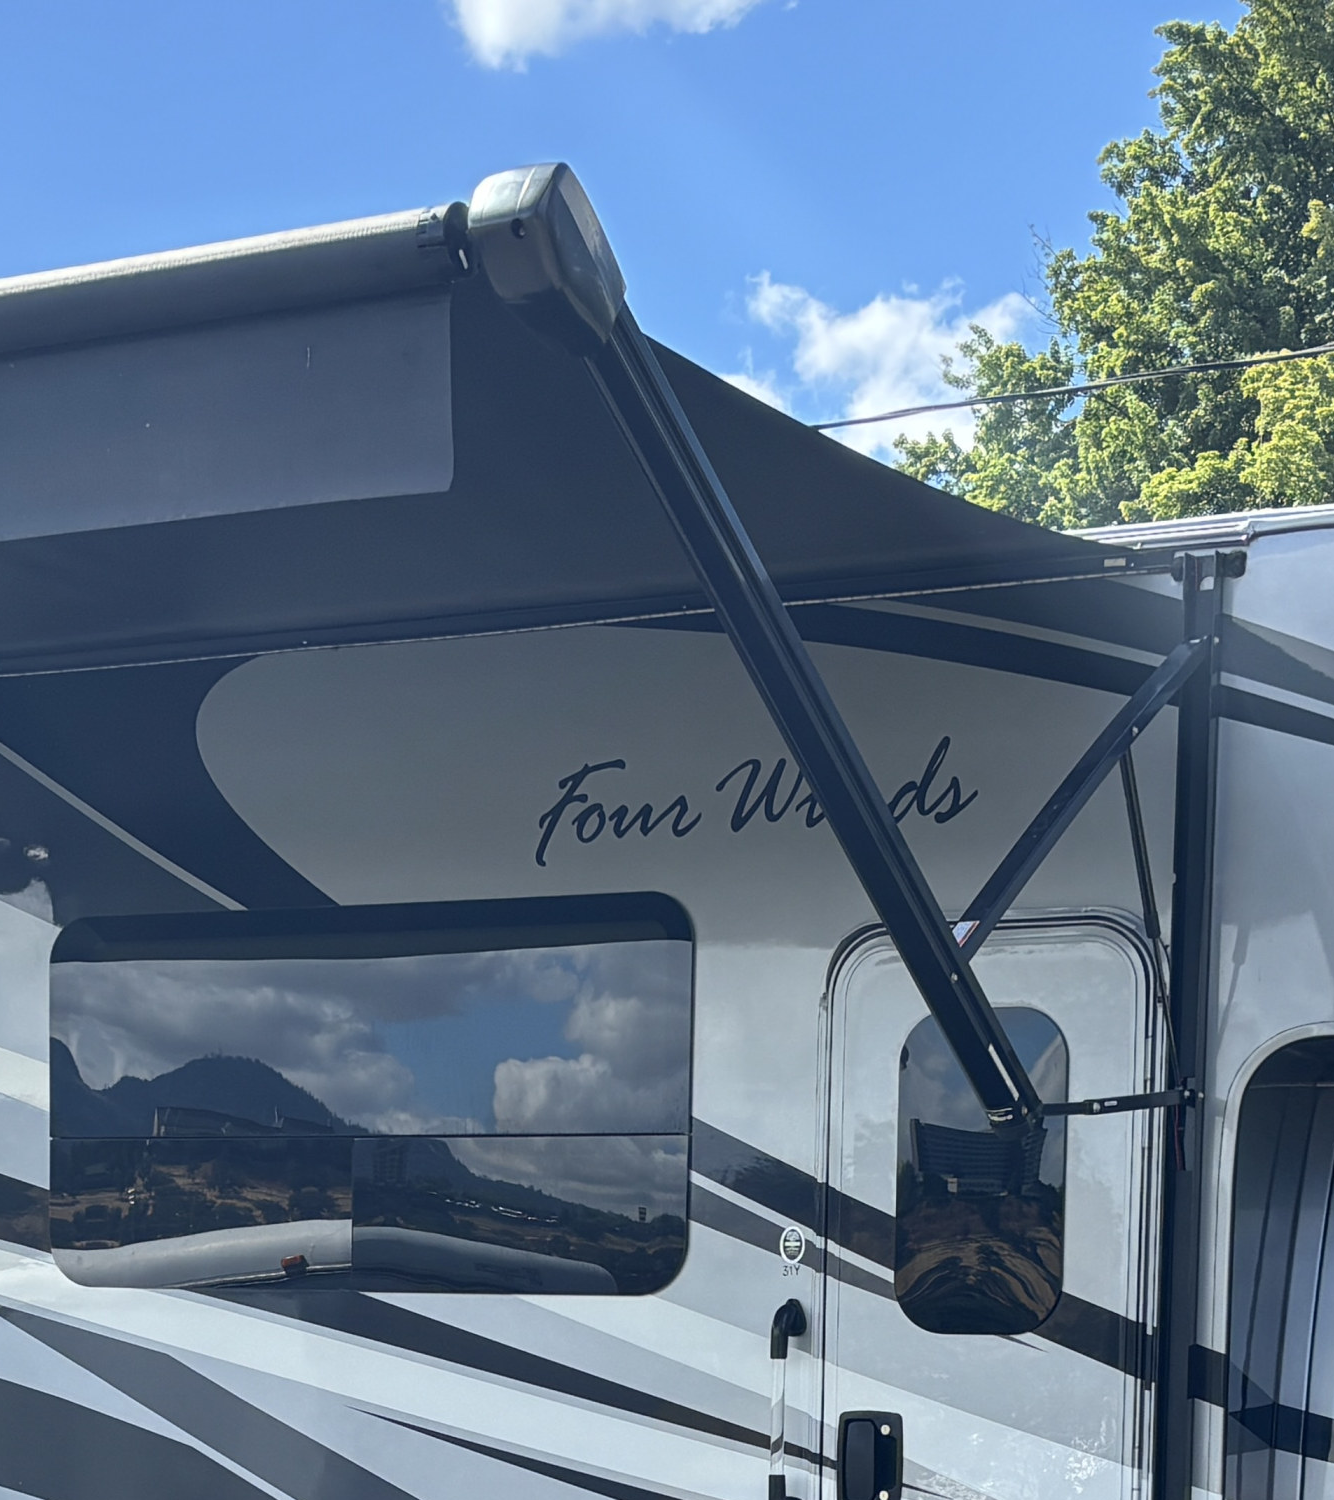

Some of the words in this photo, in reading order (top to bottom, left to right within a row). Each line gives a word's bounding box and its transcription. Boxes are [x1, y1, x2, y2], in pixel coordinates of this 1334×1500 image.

[535, 758, 702, 867] Four
[715, 736, 979, 833] Wids
[782, 1264, 801, 1277] 31Y
